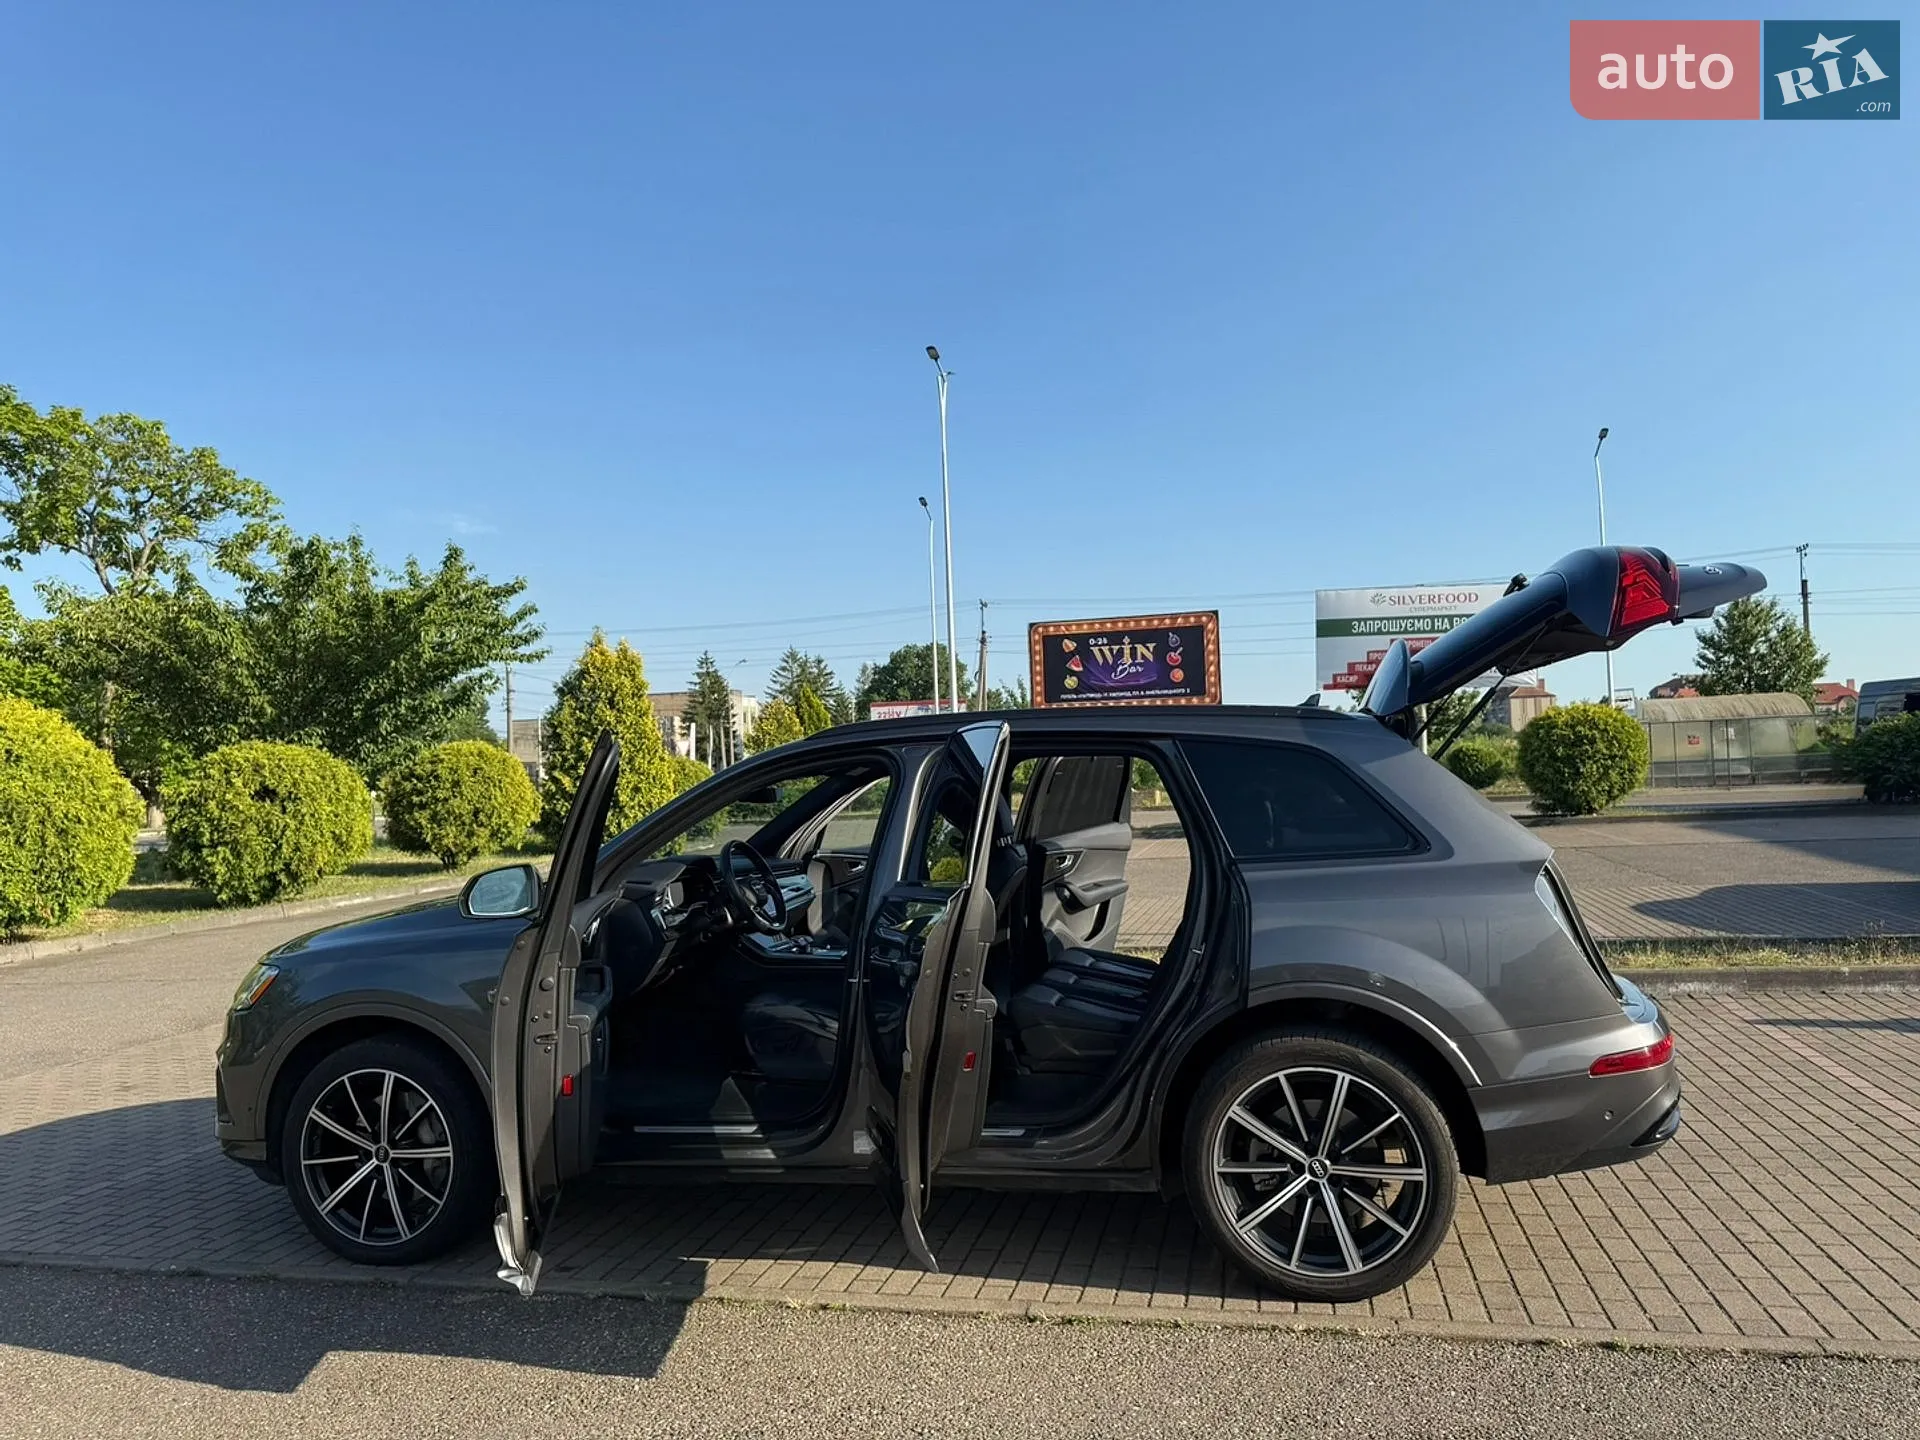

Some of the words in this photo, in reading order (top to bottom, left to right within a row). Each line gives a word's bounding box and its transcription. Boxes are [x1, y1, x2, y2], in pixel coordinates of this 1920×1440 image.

[1388, 592, 1479, 607] SILVERFOOD
[1351, 618, 1432, 634] ЗАПРОШУЄМО
[1434, 617, 1451, 631] НА
[1111, 657, 1144, 680] Bar
